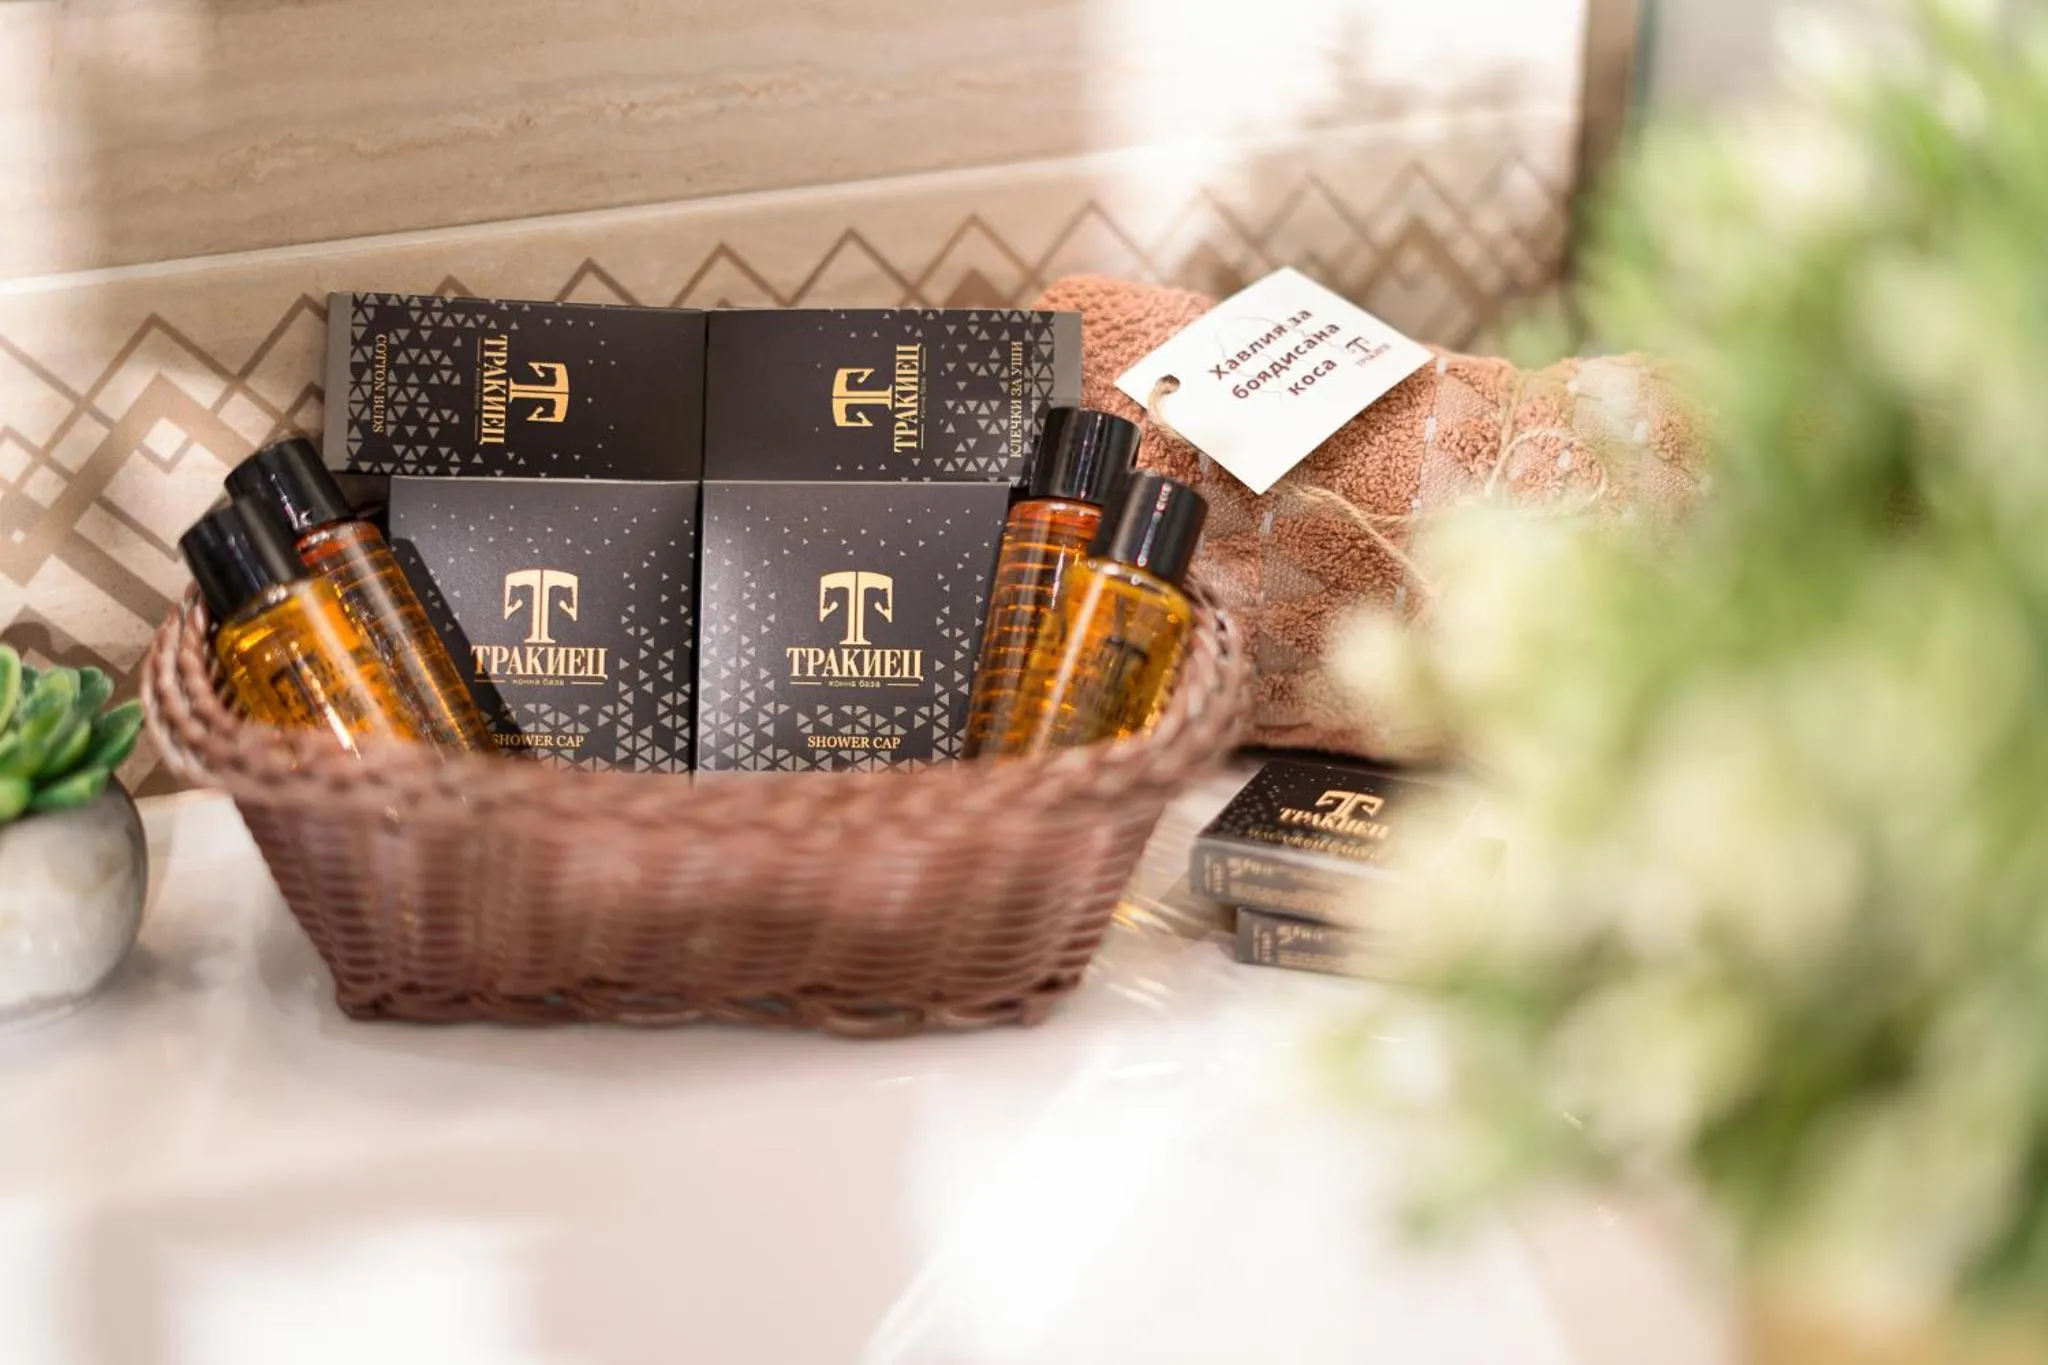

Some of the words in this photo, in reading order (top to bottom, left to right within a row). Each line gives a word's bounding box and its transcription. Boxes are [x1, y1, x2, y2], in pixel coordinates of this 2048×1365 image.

[373, 333, 388, 392] COTTON
[1010, 341, 1024, 376] УШИ
[1209, 325, 1288, 382] Хавлия
[1287, 309, 1314, 330] за
[1232, 322, 1341, 400] боядисана
[479, 334, 509, 446] ТРАКИЕЦ
[1010, 378, 1023, 397] ЗА
[1288, 358, 1338, 397] коса
[373, 395, 386, 434] BUDS
[893, 343, 922, 453] ТРАКИЕЦ
[1009, 400, 1023, 459] КЛЕЧКИ
[470, 644, 609, 680] ТРАКИЕЦ
[786, 647, 924, 682] ТРАКИЕЦ
[556, 734, 585, 748] CAP
[807, 735, 871, 749] SHOWER
[873, 736, 902, 749] CAP
